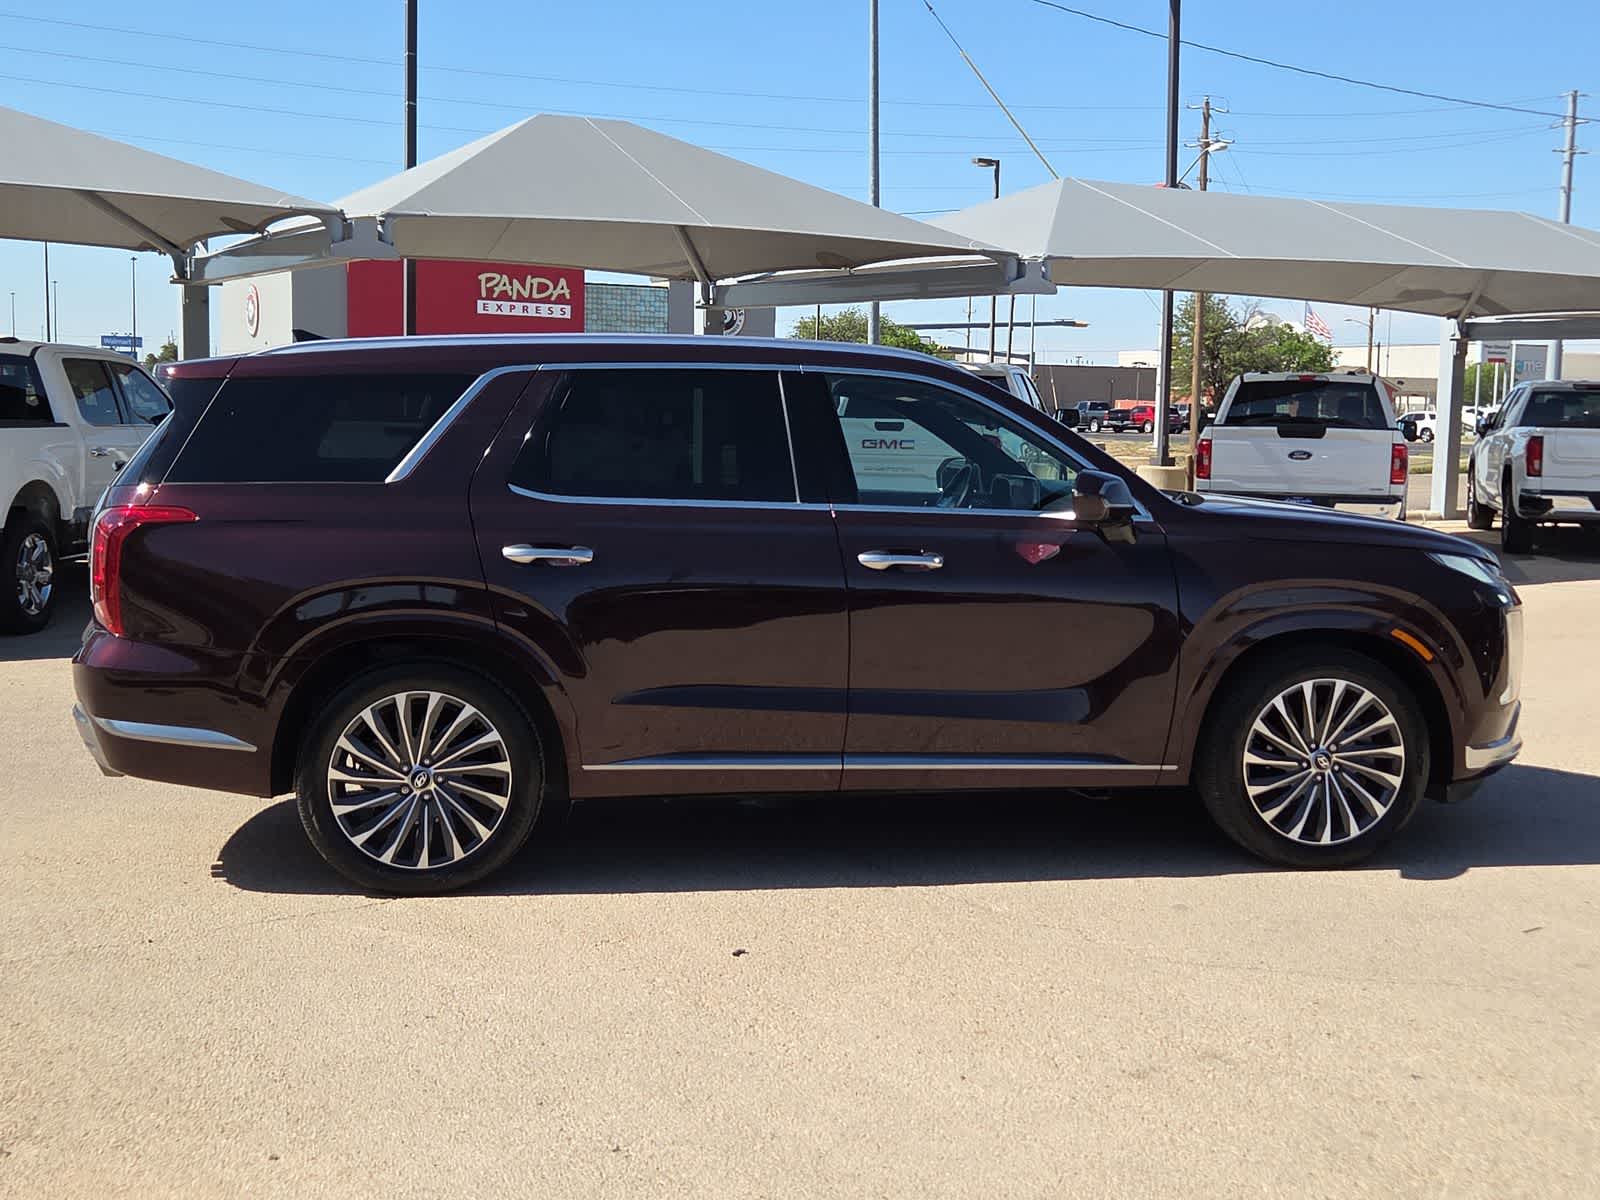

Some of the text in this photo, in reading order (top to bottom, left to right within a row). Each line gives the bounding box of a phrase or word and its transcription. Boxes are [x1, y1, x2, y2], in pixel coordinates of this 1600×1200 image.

[478, 272, 570, 301] PANDA
[482, 303, 567, 316] EXPRESS
[862, 439, 915, 449] GMC
